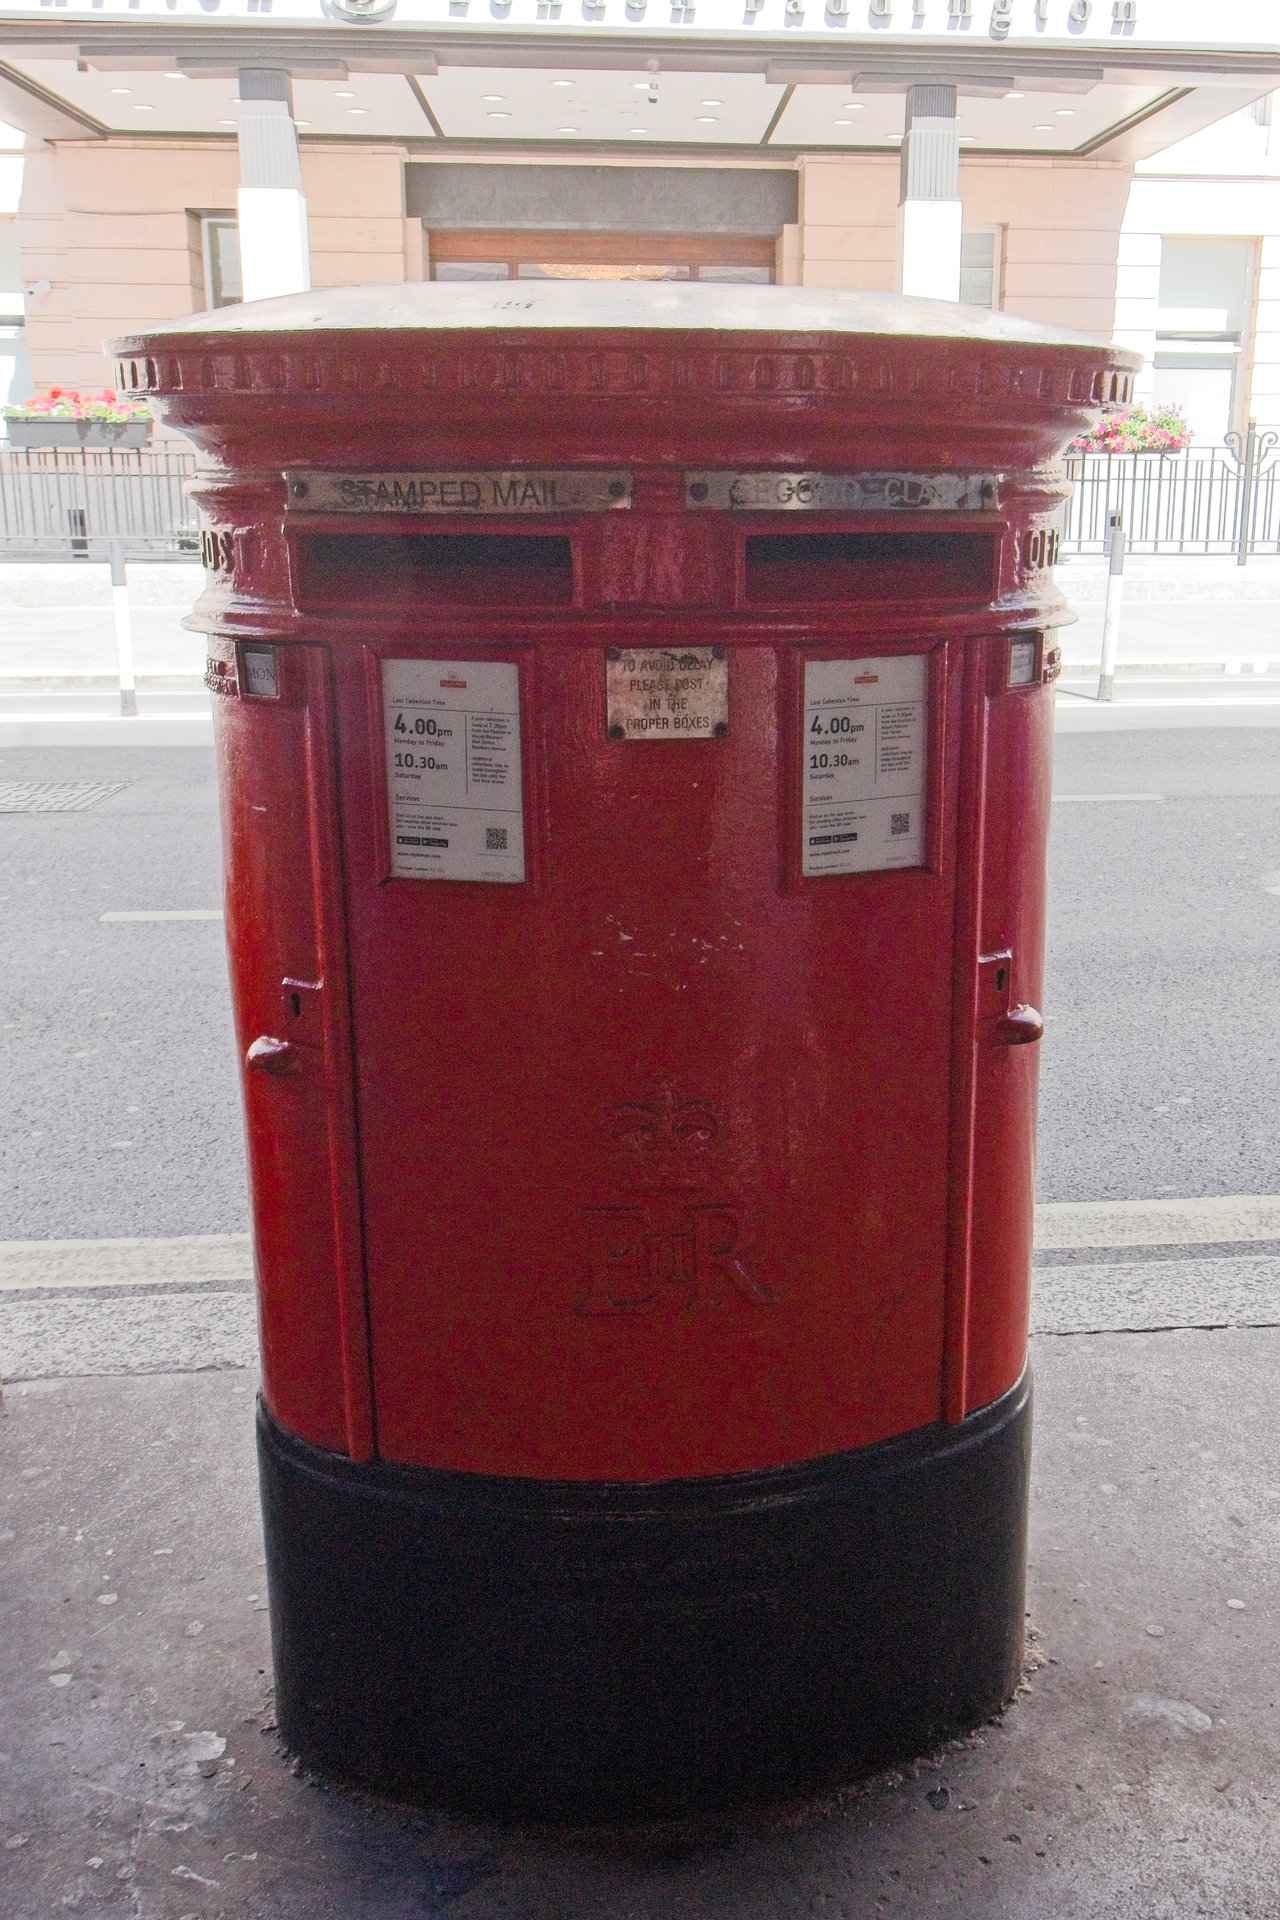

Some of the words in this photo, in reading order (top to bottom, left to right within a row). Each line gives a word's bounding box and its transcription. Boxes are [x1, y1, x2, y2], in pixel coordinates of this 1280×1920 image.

[341, 479, 481, 507] STAMPED
[493, 479, 567, 505] MAIL
[623, 659, 635, 672] TO
[640, 659, 675, 672] AVOID
[630, 679, 669, 691] PLEASE
[649, 698, 661, 711] IN
[665, 698, 688, 711] THE
[394, 713, 453, 738] 4.00pm
[626, 717, 669, 730] PROPER
[673, 716, 710, 729] BOXES
[810, 715, 864, 735] 4.00pm
[393, 738, 417, 746] Monday
[426, 739, 445, 748] Friday
[810, 738, 831, 746] Monday
[840, 736, 857, 744] Friday
[394, 753, 448, 771] 10.30am
[810, 754, 859, 769] 10.30am
[395, 772, 421, 781] Saturday
[809, 772, 834, 780] Saturday
[395, 794, 420, 802] Services
